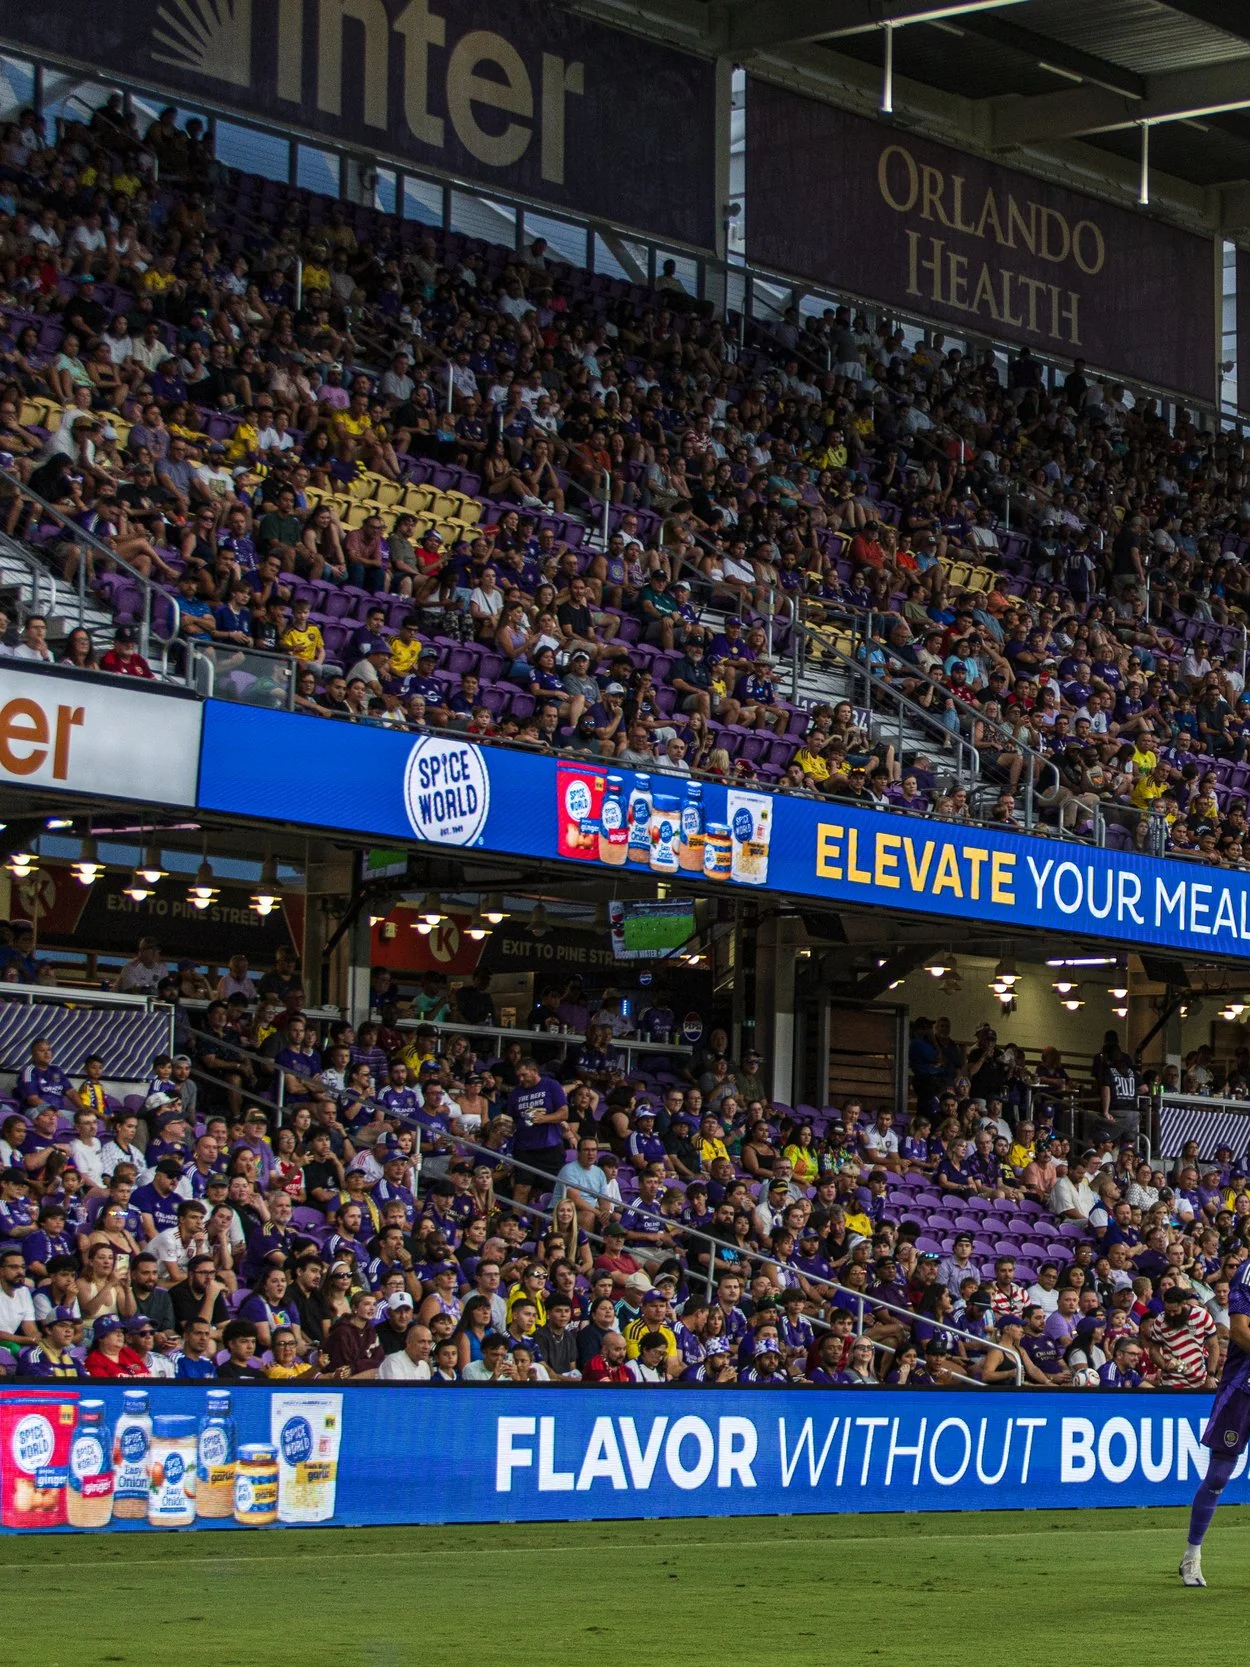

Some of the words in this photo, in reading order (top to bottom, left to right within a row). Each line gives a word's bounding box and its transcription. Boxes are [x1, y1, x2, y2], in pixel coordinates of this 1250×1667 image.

[877, 145, 1105, 274] ORLANDO
[905, 229, 1083, 346] HEALTH
[418, 750, 470, 789] SPICE
[418, 784, 477, 825] WORLD
[816, 822, 1016, 905] ELEVATE
[1026, 856, 1144, 925] YOUR
[148, 896, 168, 916] TO
[502, 939, 531, 956] EXIT
[534, 944, 553, 959] TO
[556, 945, 587, 962] PINE
[496, 1416, 757, 1491] FLAVOR
[778, 1416, 1047, 1487] WITHOUT
[119, 1474, 147, 1488] Onion
